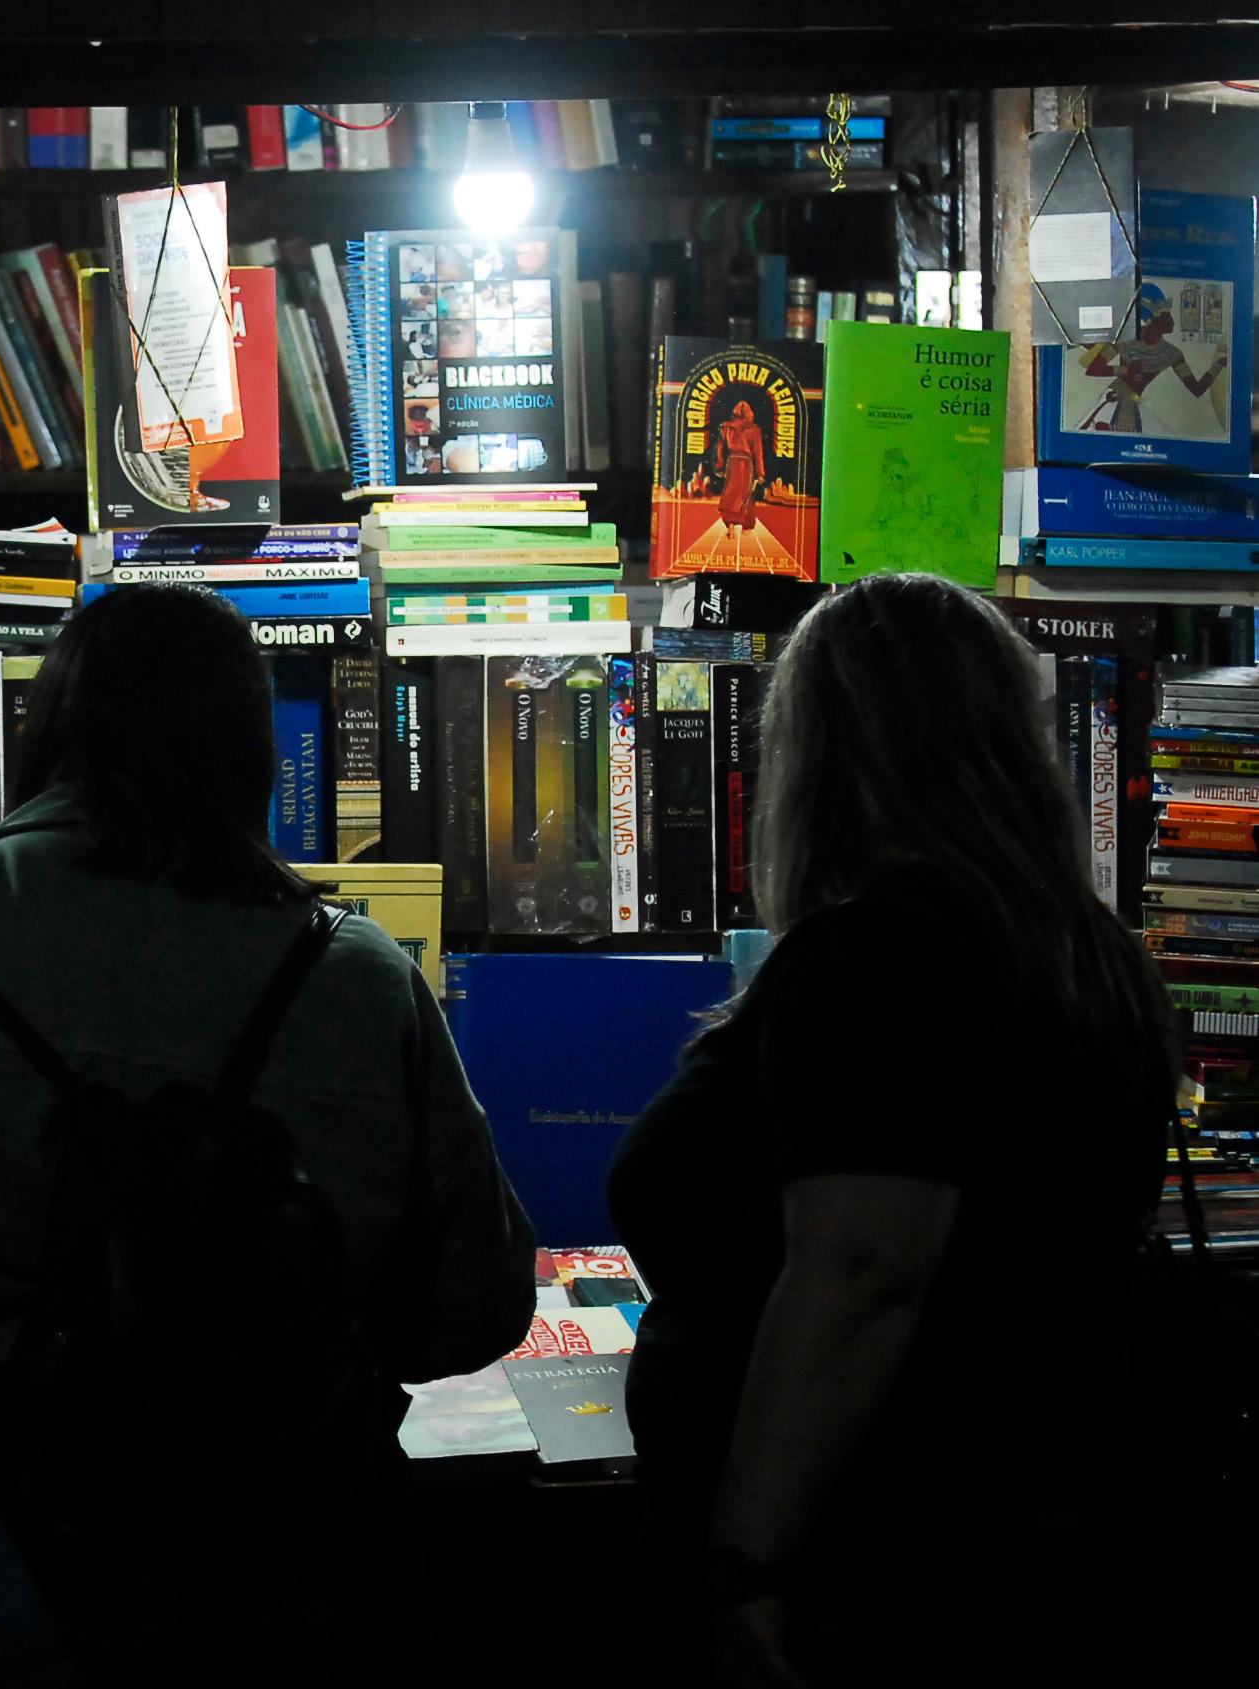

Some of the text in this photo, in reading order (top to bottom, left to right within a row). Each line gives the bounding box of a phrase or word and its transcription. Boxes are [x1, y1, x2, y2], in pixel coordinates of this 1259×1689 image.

[915, 343, 995, 369] Humor
[446, 364, 554, 388] BLACKBOOK
[920, 368, 992, 392] é coisa
[447, 391, 554, 411] CLÍNICA MÉDICA
[687, 363, 796, 459] UM PARA LEIBOWITZ
[940, 398, 991, 417] séria
[1106, 503, 1173, 513] O IDIOTA DA
[683, 552, 724, 565] WALTER
[740, 555, 774, 567] MILLER
[1049, 546, 1127, 560] KARL POPPER
[119, 571, 132, 580] O
[9, 626, 17, 635] A
[17, 626, 44, 637] VELA
[1037, 617, 1115, 640] STOKER
[345, 708, 373, 719] GOD'S
[518, 694, 530, 740] O Novo
[579, 693, 591, 739] O Novo
[641, 692, 650, 718] WELLS
[664, 717, 705, 729] JACQUES
[729, 678, 739, 763] PATRICK LESCOT
[1069, 702, 1079, 737] LOVE
[408, 686, 422, 791] manual do artista
[664, 729, 704, 739] LE GOFF
[609, 740, 633, 796] CORES
[1093, 738, 1115, 794] CORES
[282, 759, 295, 825] SRIMAD
[302, 733, 316, 851] BHAGAVATAM
[612, 799, 635, 856] VIVAS
[1093, 797, 1115, 853] VIVAS
[1188, 830, 1209, 841] JOHN
